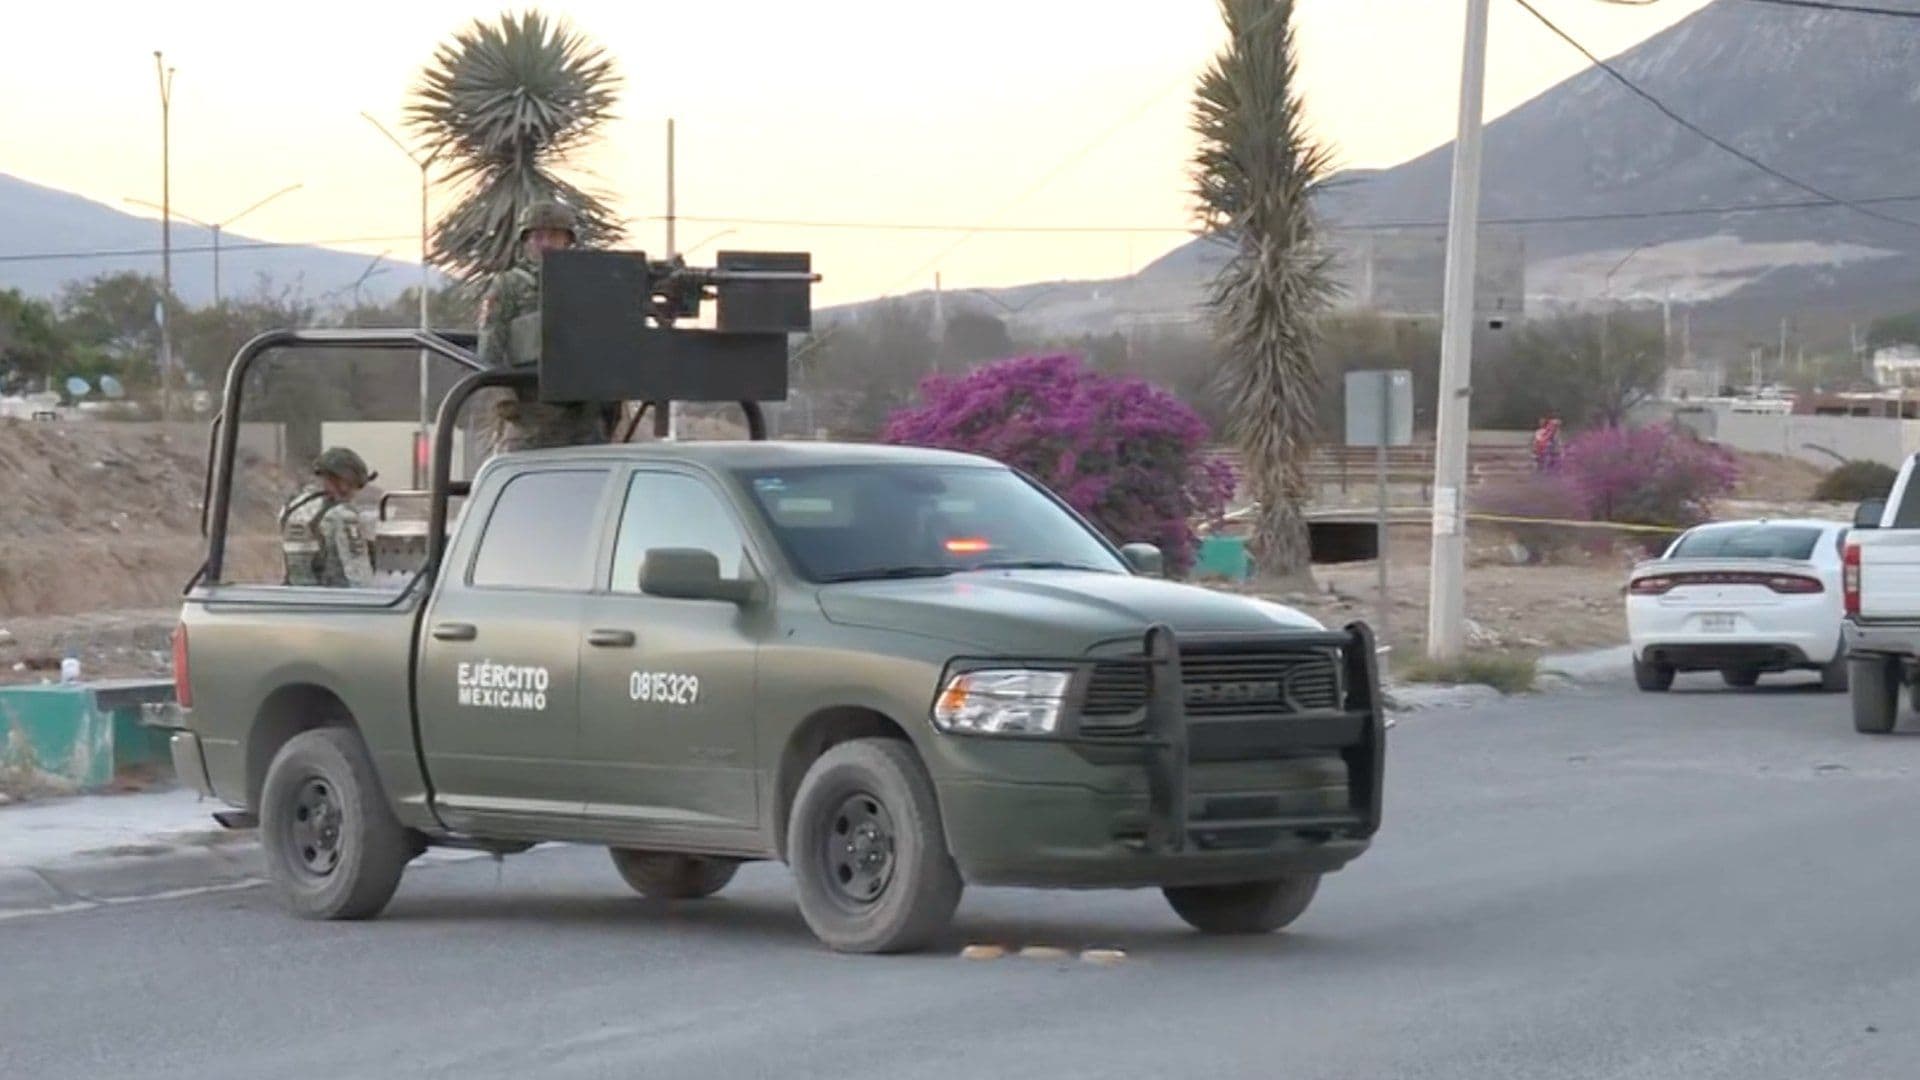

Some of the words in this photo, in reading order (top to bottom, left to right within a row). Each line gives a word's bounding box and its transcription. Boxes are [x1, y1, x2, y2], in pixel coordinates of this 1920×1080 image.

[458, 659, 549, 690] EJÉRCITO
[630, 671, 699, 704] 0815329
[458, 688, 547, 711] MEXICANO
